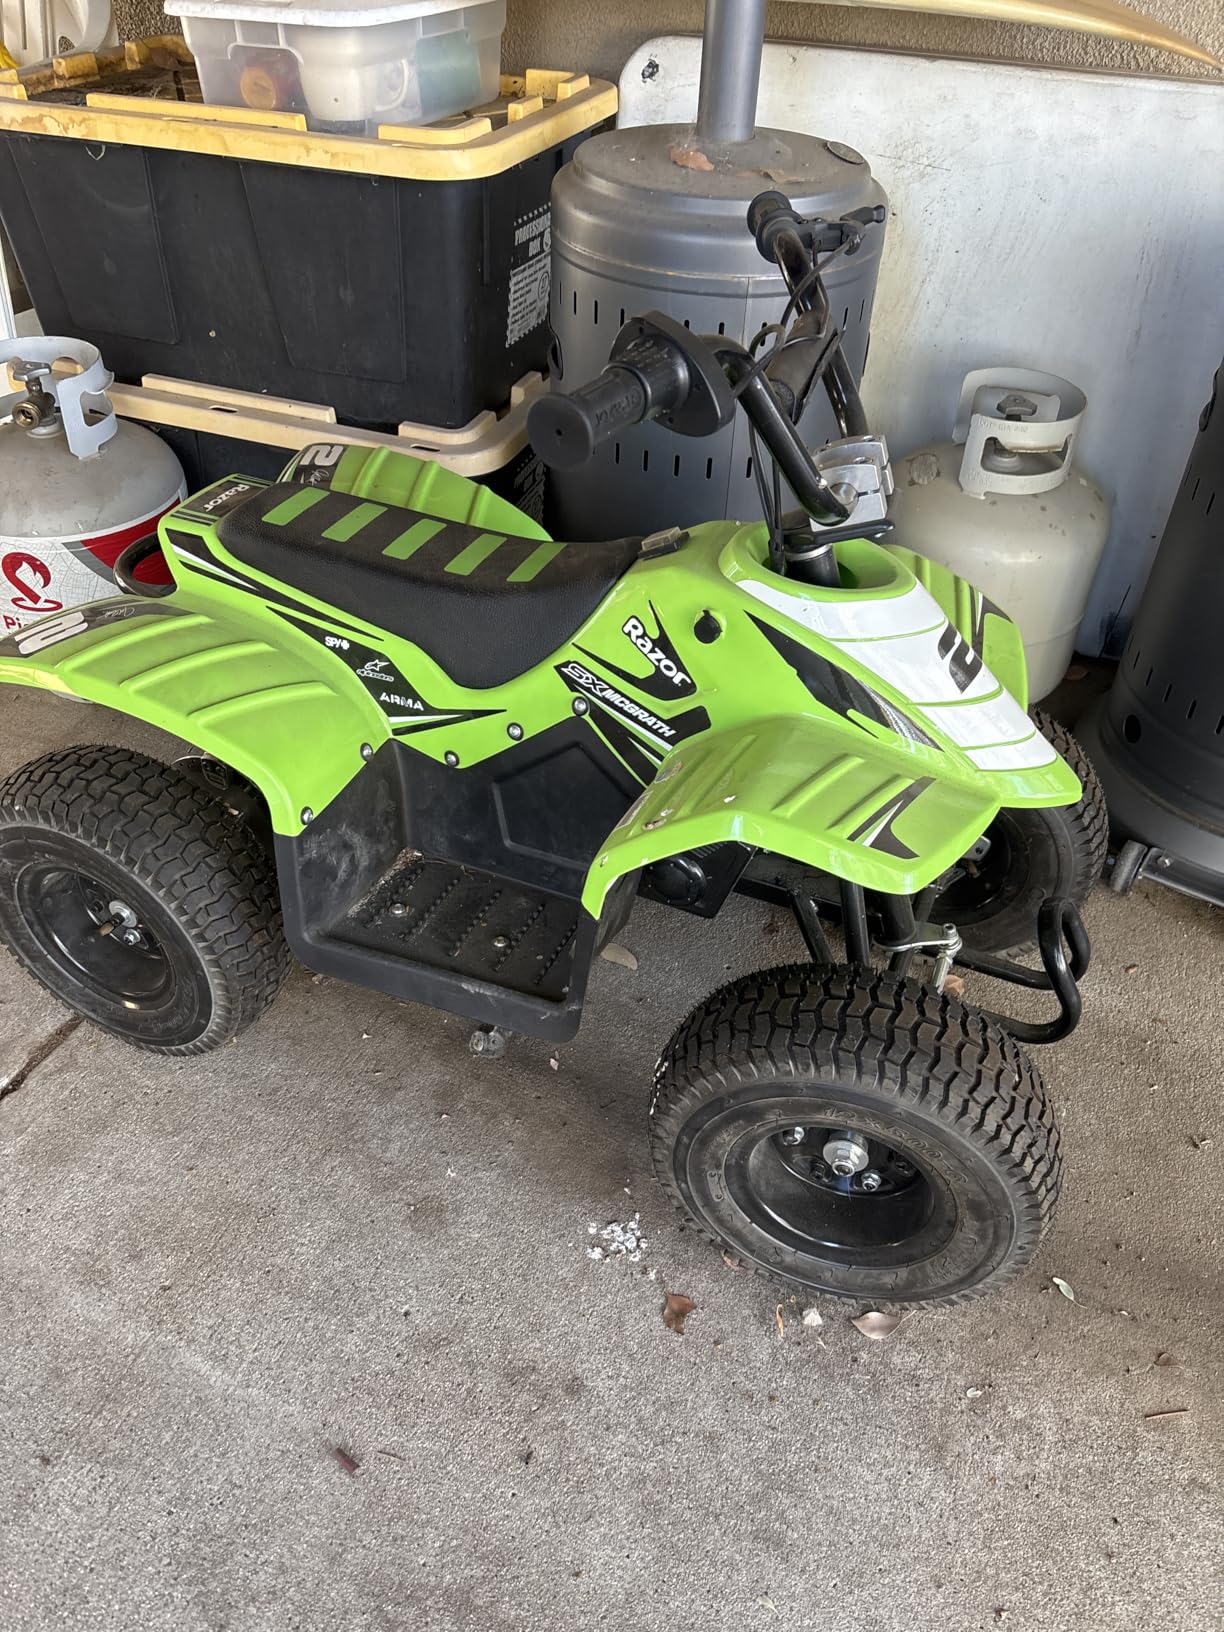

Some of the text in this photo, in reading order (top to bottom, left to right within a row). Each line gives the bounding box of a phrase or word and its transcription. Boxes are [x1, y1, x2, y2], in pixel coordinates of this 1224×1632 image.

[300, 444, 344, 467] 2
[203, 483, 251, 512] Razor
[3, 614, 29, 630] Pi
[14, 611, 89, 655] 2
[622, 616, 692, 687] Razor
[380, 692, 425, 712] ARMA
[560, 662, 677, 738] SX MCGRATH
